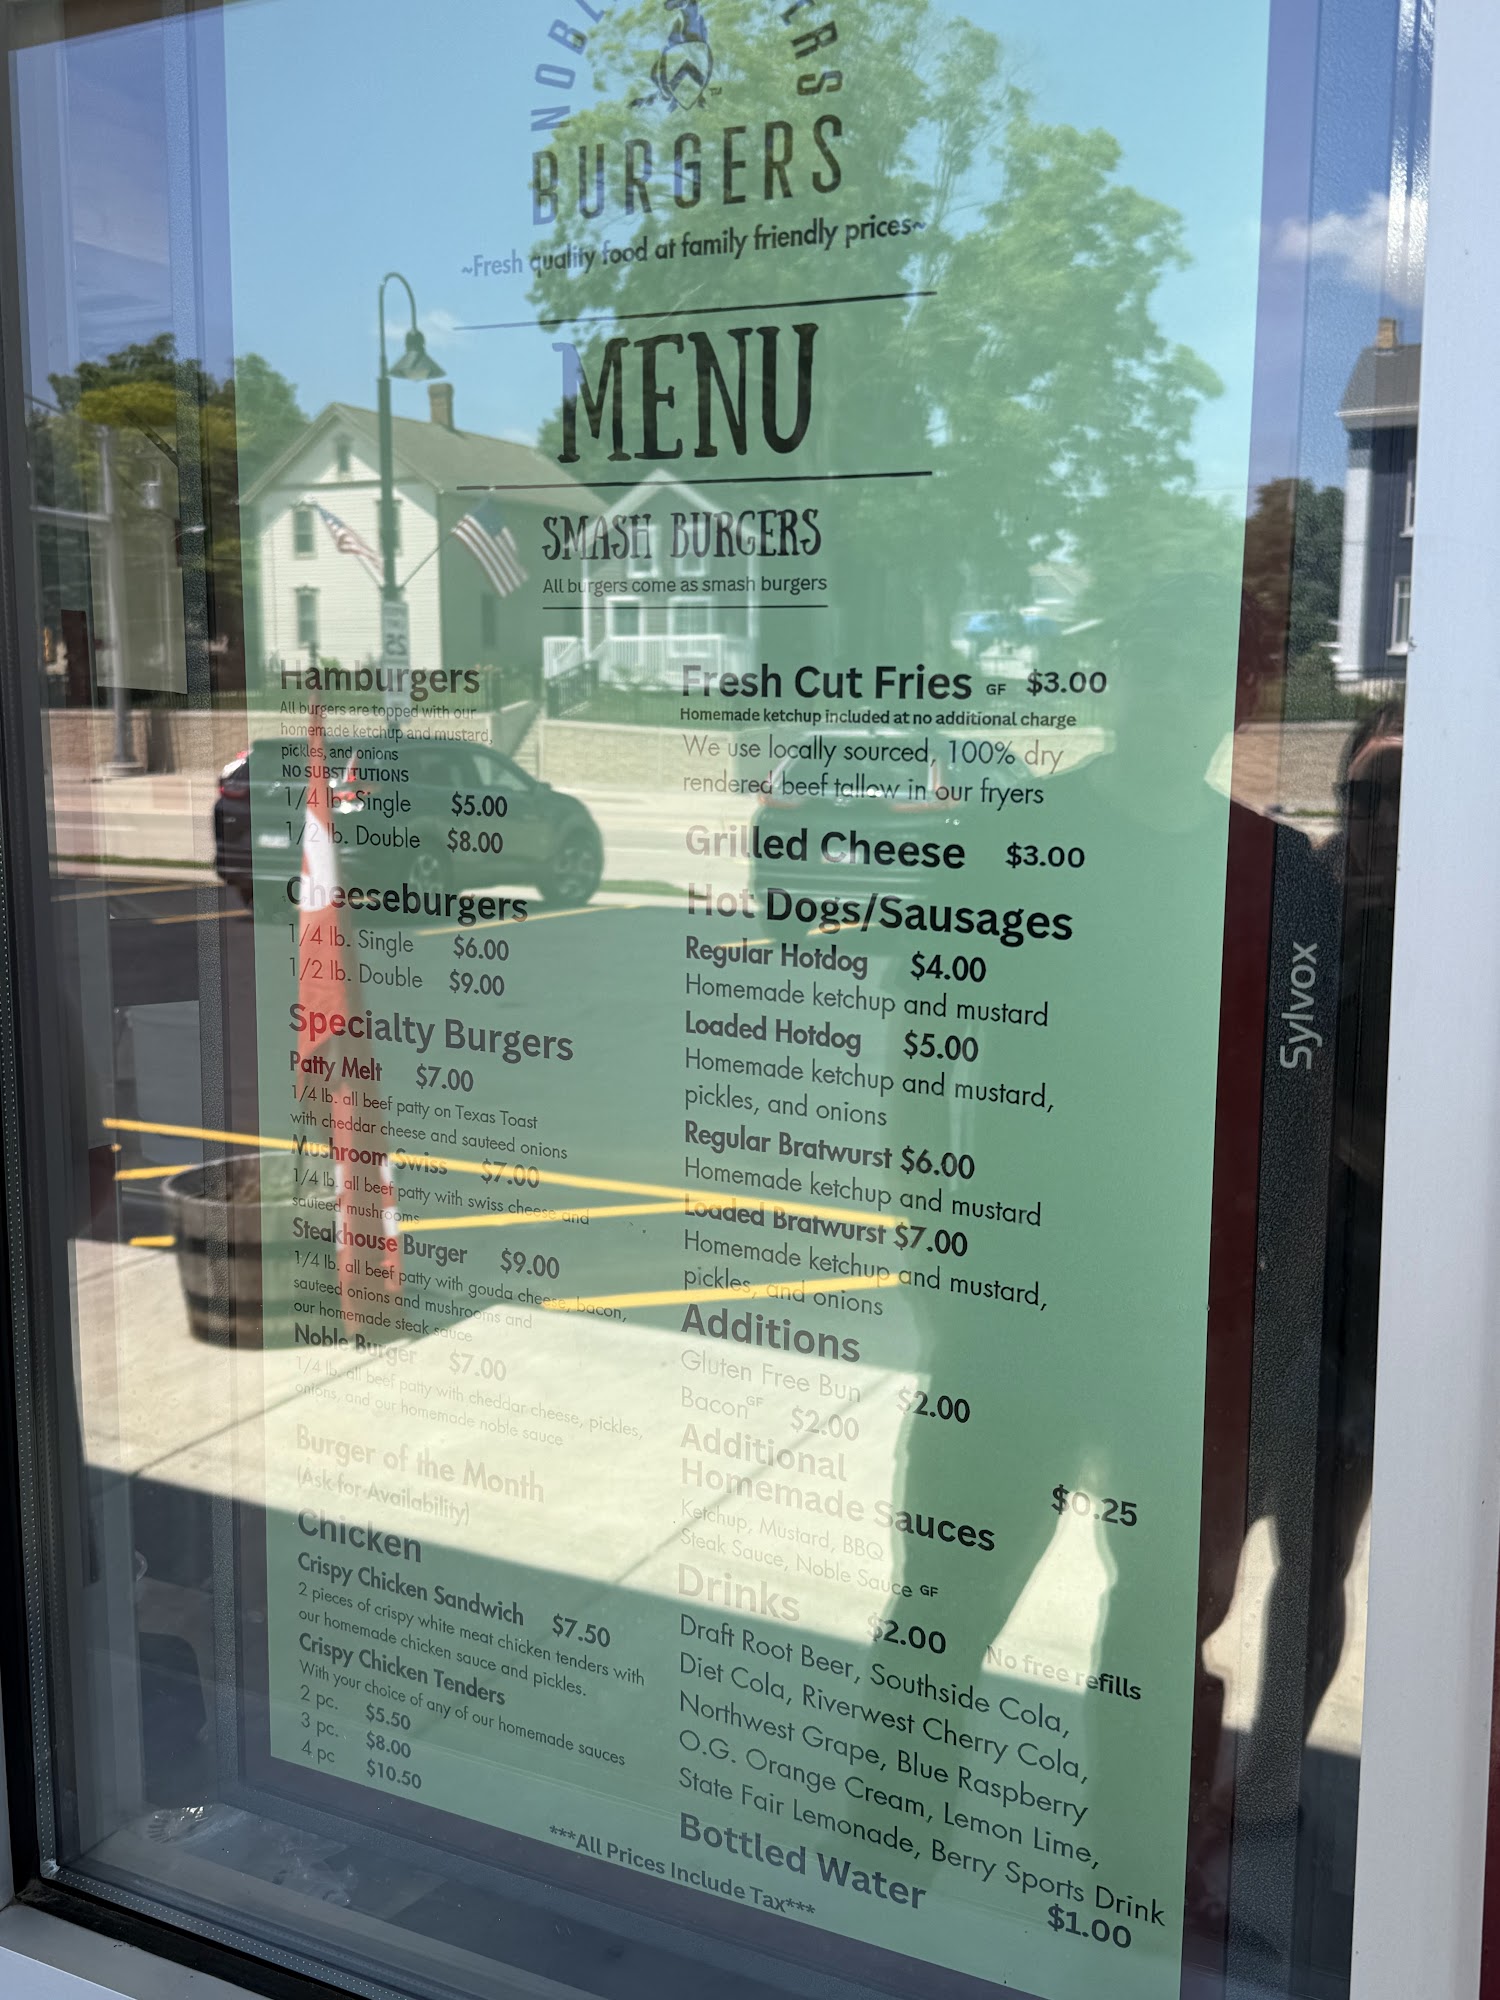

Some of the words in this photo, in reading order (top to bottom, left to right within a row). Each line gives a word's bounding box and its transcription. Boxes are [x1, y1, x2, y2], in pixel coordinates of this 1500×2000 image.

[531, 0, 606, 131] NOBL
[532, 114, 842, 225] BURGERS
[529, 244, 596, 278] quality
[603, 237, 648, 266] food
[655, 241, 676, 260] at
[681, 227, 748, 259] family
[754, 218, 838, 251] friendly
[552, 323, 819, 463] MENU
[542, 514, 652, 560] SMASH
[670, 509, 821, 558] BURGERS
[543, 578, 562, 593] All
[569, 579, 627, 597] burgers
[632, 578, 676, 592] come
[680, 579, 698, 591] as
[702, 576, 755, 591] smash
[762, 576, 827, 595] burgers
[280, 660, 480, 701] Hamburgers
[682, 664, 781, 698] Fresh
[794, 666, 863, 699] Cut
[875, 664, 972, 700] Fries
[986, 683, 1006, 695] GF
[1026, 669, 1107, 695] $3.00
[280, 701, 295, 713] All
[300, 701, 346, 719] burgers
[350, 706, 370, 716] are
[373, 704, 418, 721] topped
[422, 706, 449, 718] with
[454, 709, 476, 719] our
[280, 722, 349, 737] homemade
[352, 725, 403, 743] ketchup
[406, 728, 430, 740] and
[434, 728, 493, 744] mustard,
[680, 708, 760, 722] Homemade
[764, 709, 821, 726] ketchup
[825, 709, 890, 726] included
[894, 713, 909, 725] at
[913, 713, 932, 725] no
[935, 711, 1017, 726] additional
[1020, 713, 1076, 728] charge
[281, 744, 326, 760] pickles,
[330, 746, 352, 759] and
[356, 748, 398, 760] onions
[282, 764, 301, 778] NO
[683, 734, 720, 756] We
[728, 741, 761, 758] use
[769, 735, 836, 767] locally
[843, 738, 936, 767] sourced,
[950, 739, 1015, 765] 100%
[1024, 740, 1065, 774] dry
[285, 787, 320, 808] 1/4
[356, 790, 411, 818] Single
[451, 792, 508, 818] $5.00
[286, 822, 320, 843] 1/2
[328, 824, 348, 844] lb.
[356, 826, 420, 848] Double
[448, 828, 503, 854] $8.00
[685, 825, 808, 861] Grilled
[820, 830, 965, 869] Cheese
[1006, 843, 1085, 869] $3.00
[287, 876, 528, 928] Cheeseburgers
[688, 883, 755, 919] Hot
[767, 888, 1073, 947] Dogs/Sausages
[290, 924, 323, 946] 1/4
[330, 925, 351, 947] lb.
[358, 929, 414, 957] Single
[453, 935, 509, 961] $6.00
[686, 935, 773, 968] Regular
[781, 943, 868, 980] Hotdog
[910, 951, 986, 983] $4.00
[290, 958, 323, 981] 1/2
[330, 959, 352, 981] lb.
[359, 964, 423, 988] Double
[449, 970, 504, 997] $9.00
[686, 973, 804, 1004] Homemade
[813, 981, 896, 1019] ketchup
[904, 993, 947, 1018] and
[956, 1001, 1048, 1027] mustard
[1280, 941, 1322, 1069] Sylvox
[289, 1004, 435, 1053] Specialty
[445, 1019, 573, 1064] Burgers
[685, 1010, 767, 1041] Loaded
[776, 1019, 861, 1057] Hotdog
[903, 1030, 978, 1062] $5.00
[290, 1054, 335, 1081] Patty
[342, 1057, 382, 1081] Melt
[416, 1064, 473, 1092] $7.00
[292, 1085, 317, 1102] 1/4
[321, 1087, 338, 1104] lb.
[343, 1089, 358, 1106] all
[363, 1091, 393, 1111] beef
[397, 1099, 430, 1119] patty
[434, 1106, 451, 1119] on
[455, 1105, 495, 1125] Texas
[500, 1111, 538, 1129] Toast
[686, 1120, 770, 1154] Regular
[779, 1132, 892, 1169] Bratwurst
[900, 1145, 975, 1180] $6.00
[293, 1217, 398, 1252] Steakhouse
[404, 1234, 467, 1266] Burger
[500, 1248, 560, 1279] $9.00
[685, 1194, 764, 1227] Loaded
[773, 1206, 886, 1245] Bratwurst
[893, 1222, 968, 1257] $7.00
[680, 1303, 860, 1363] Additions
[680, 1423, 848, 1482] Additional
[680, 1458, 865, 1522] Homemade
[873, 1500, 995, 1552] Sauces
[1051, 1484, 1137, 1527] $0.25
[298, 1507, 421, 1562] Chicken
[298, 1551, 353, 1585] Crispy
[358, 1567, 427, 1601] Chicken
[434, 1586, 524, 1626] Sandwich
[552, 1614, 610, 1648] $7.50
[678, 1564, 800, 1622] Drinks
[299, 1633, 354, 1667] Crispy
[359, 1649, 428, 1684] Chicken
[434, 1669, 506, 1706] Tenders
[680, 1614, 735, 1648] Draft
[742, 1630, 793, 1663] Root
[801, 1646, 861, 1683] Beer,
[870, 1663, 990, 1713] Southside
[1000, 1697, 1070, 1737] Cola,
[300, 1685, 310, 1701] 2
[316, 1692, 338, 1710] pc.
[366, 1703, 411, 1730] $5.50
[301, 1713, 310, 1728] 3
[316, 1720, 339, 1738] pc.
[366, 1731, 411, 1758] $8.00
[301, 1740, 311, 1756] 4
[317, 1747, 335, 1764] pc
[366, 1759, 422, 1789] $10.50
[607, 1842, 665, 1875] Prices
[671, 1862, 745, 1899] Include
[679, 1767, 733, 1802] State
[741, 1785, 784, 1815] Fair
[793, 1805, 920, 1860] Lemonade,
[931, 1840, 997, 1882] Berry
[1005, 1860, 1085, 1905] Sports
[1096, 1886, 1166, 1928] Drink
[680, 1811, 806, 1875] Bottled
[817, 1851, 927, 1909] Water
[1047, 1904, 1132, 1949] $1.00
